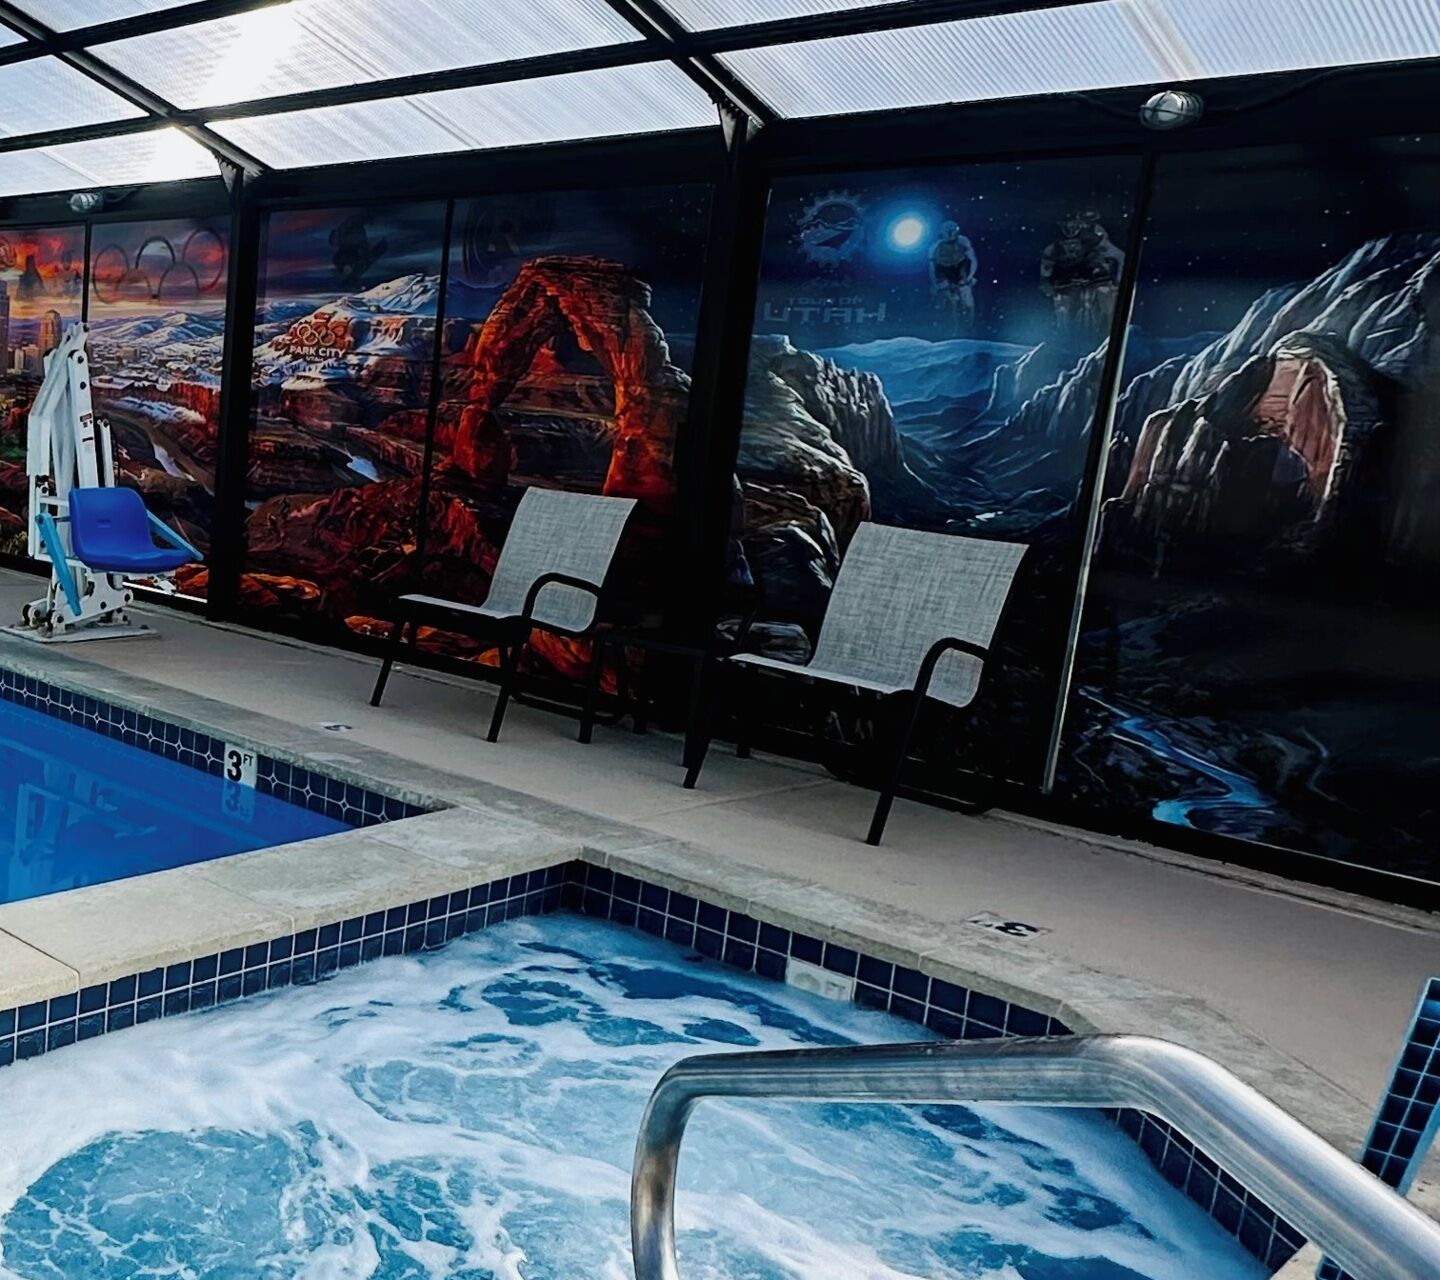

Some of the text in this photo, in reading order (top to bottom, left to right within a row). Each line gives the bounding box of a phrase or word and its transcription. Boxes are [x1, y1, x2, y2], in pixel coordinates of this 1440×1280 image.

[763, 301, 888, 325] UTAH
[290, 345, 346, 358] PARK CITY
[226, 749, 254, 783] 3 FT
